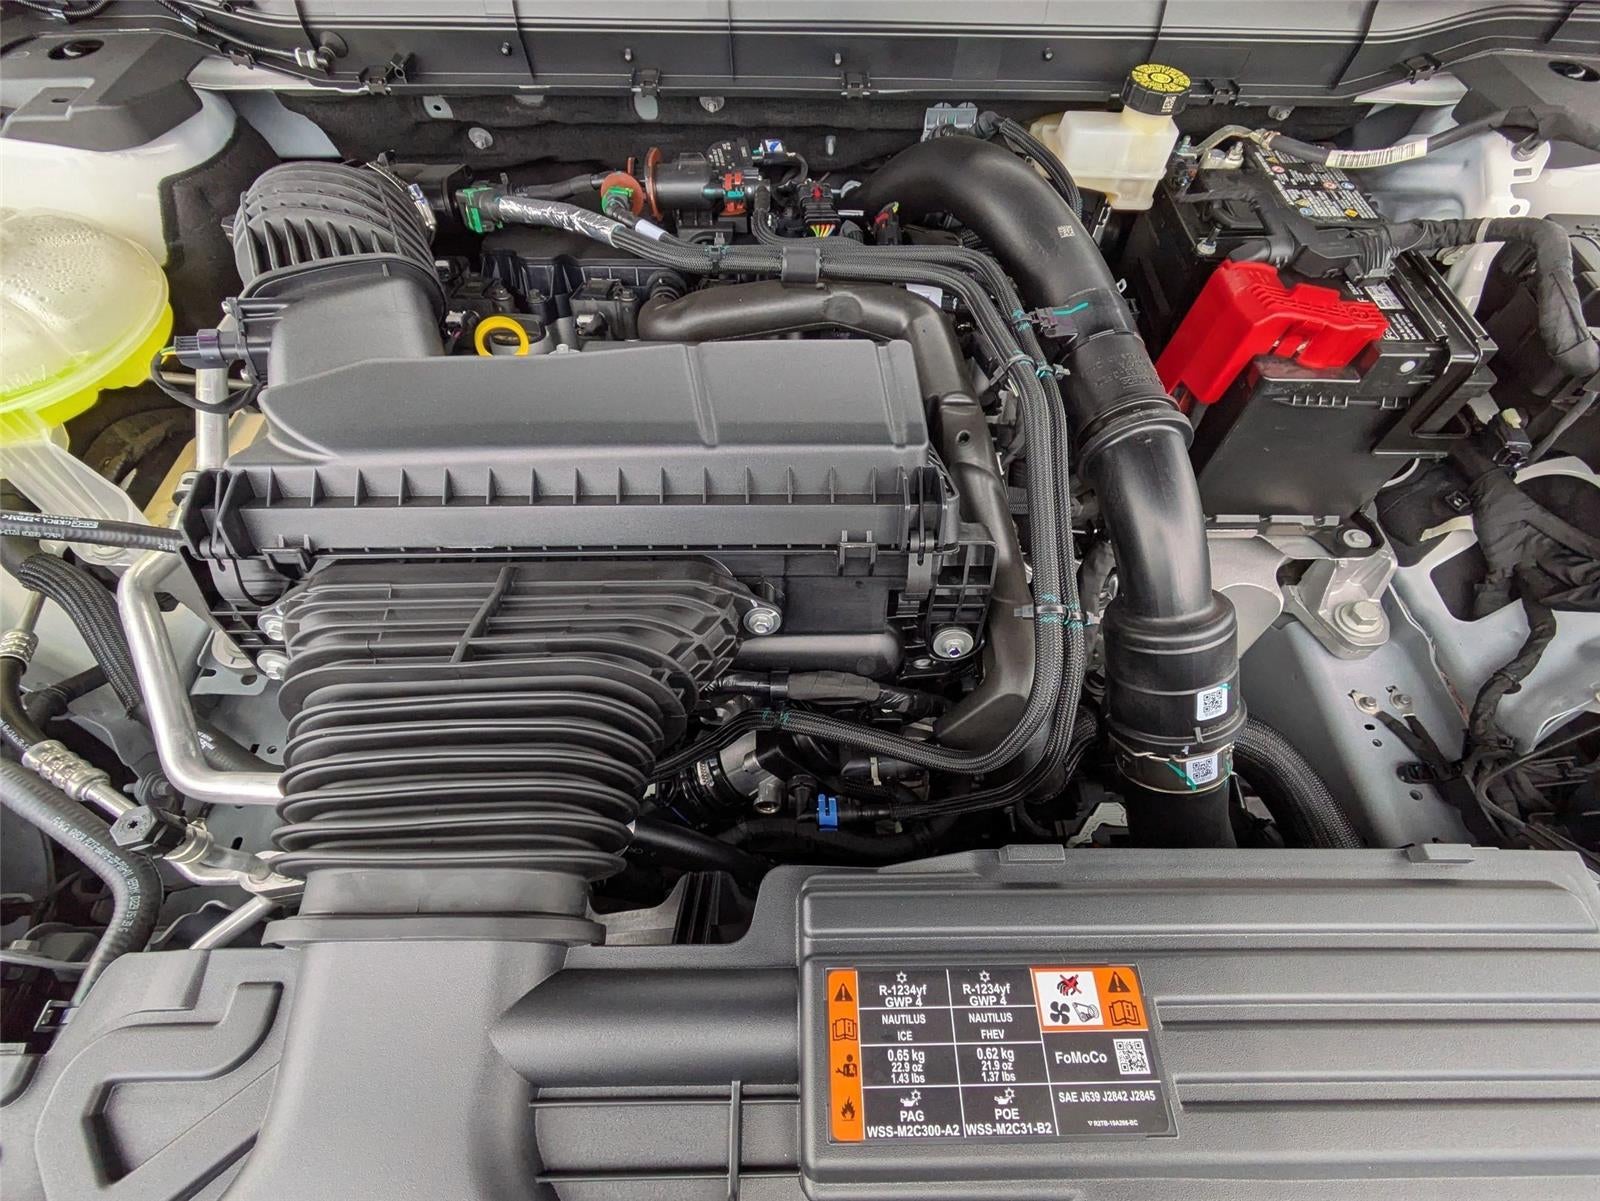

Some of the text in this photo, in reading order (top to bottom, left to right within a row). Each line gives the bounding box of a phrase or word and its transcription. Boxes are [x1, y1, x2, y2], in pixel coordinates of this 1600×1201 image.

[879, 984, 927, 997] R-1234yf
[962, 983, 1011, 996] R-1234yf
[885, 997, 923, 1008] GWP 4
[969, 995, 1007, 1006] GWP 4
[881, 1013, 926, 1024] NAUTILUS
[968, 1012, 1013, 1023] NAUTILUS
[897, 1030, 913, 1041] ICE
[980, 1028, 1005, 1040] FHEV
[887, 1048, 926, 1064] 0.65 kg
[976, 1047, 1015, 1062] 0.62 kg
[1054, 1050, 1108, 1064] FoMoCo
[891, 1062, 924, 1073] 22.9 oz
[981, 1060, 1014, 1071] 21.9 oz
[891, 1072, 926, 1084] 1.43 lbs
[981, 1070, 1017, 1082] 1.37 lbs
[1058, 1090, 1156, 1103] SAE J639 J2842 J2845
[899, 1110, 925, 1122] PAG
[994, 1107, 1020, 1120] POE
[866, 1123, 960, 1138] WSS-M2C300-A2
[965, 1121, 1053, 1136] WSS-M2C31-B2
